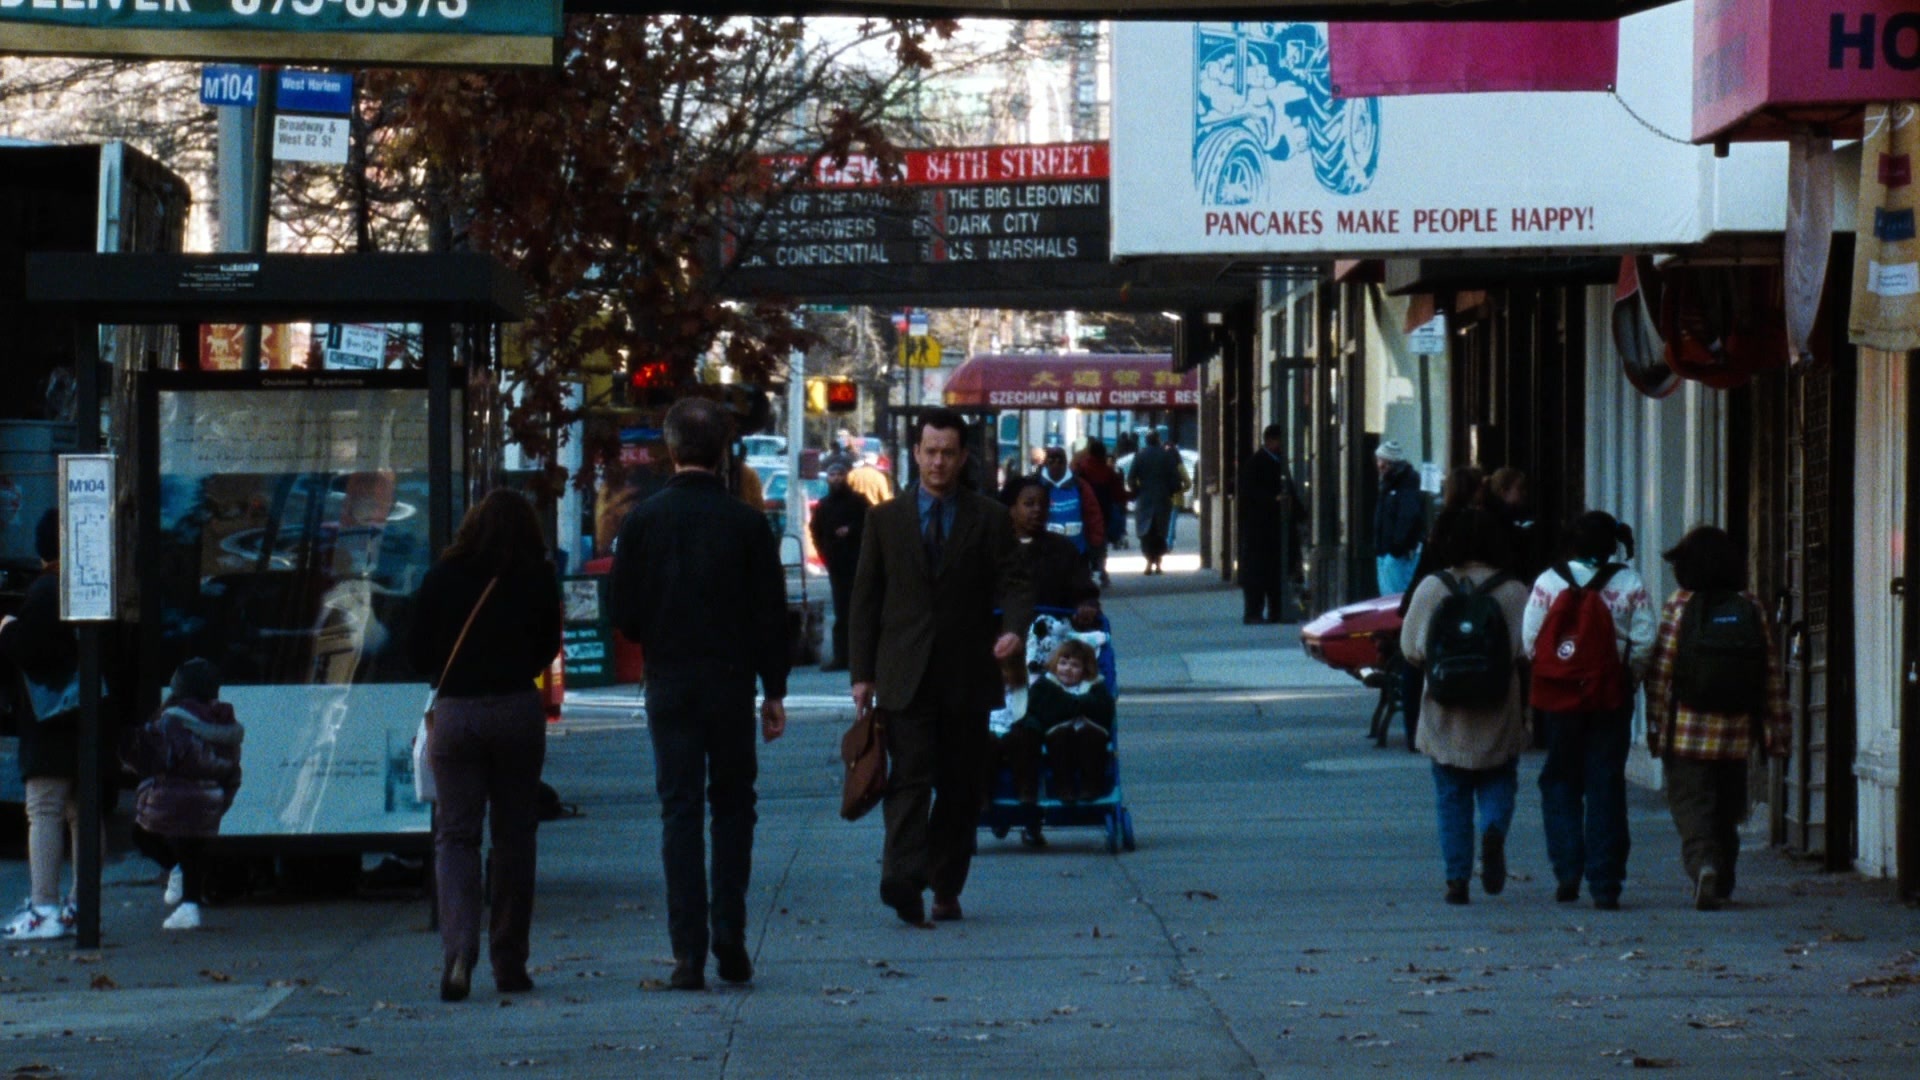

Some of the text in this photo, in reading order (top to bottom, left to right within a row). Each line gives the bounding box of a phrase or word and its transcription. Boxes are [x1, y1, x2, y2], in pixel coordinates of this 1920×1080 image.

[1829, 12, 1920, 70] HO
[204, 74, 254, 101] M104
[281, 77, 341, 92] West Harlem
[279, 118, 324, 134] Broadway
[279, 134, 302, 146] West
[321, 135, 332, 147] St
[926, 150, 988, 181] 84TH
[1000, 145, 1095, 177] STREET
[790, 196, 811, 214] OF
[949, 184, 1100, 208] THE BIG LEBOWSKI
[948, 213, 1041, 235] DARK CITY
[1205, 206, 1595, 236] PANCAKES MAKE PEOPLE HAPPY!
[776, 244, 889, 267] CONFIDENTIAL
[988, 238, 1078, 259] MARSHALS
[989, 391, 1058, 405] SZECHUAN
[1110, 391, 1166, 405] CHINESE
[69, 479, 105, 492] M104
